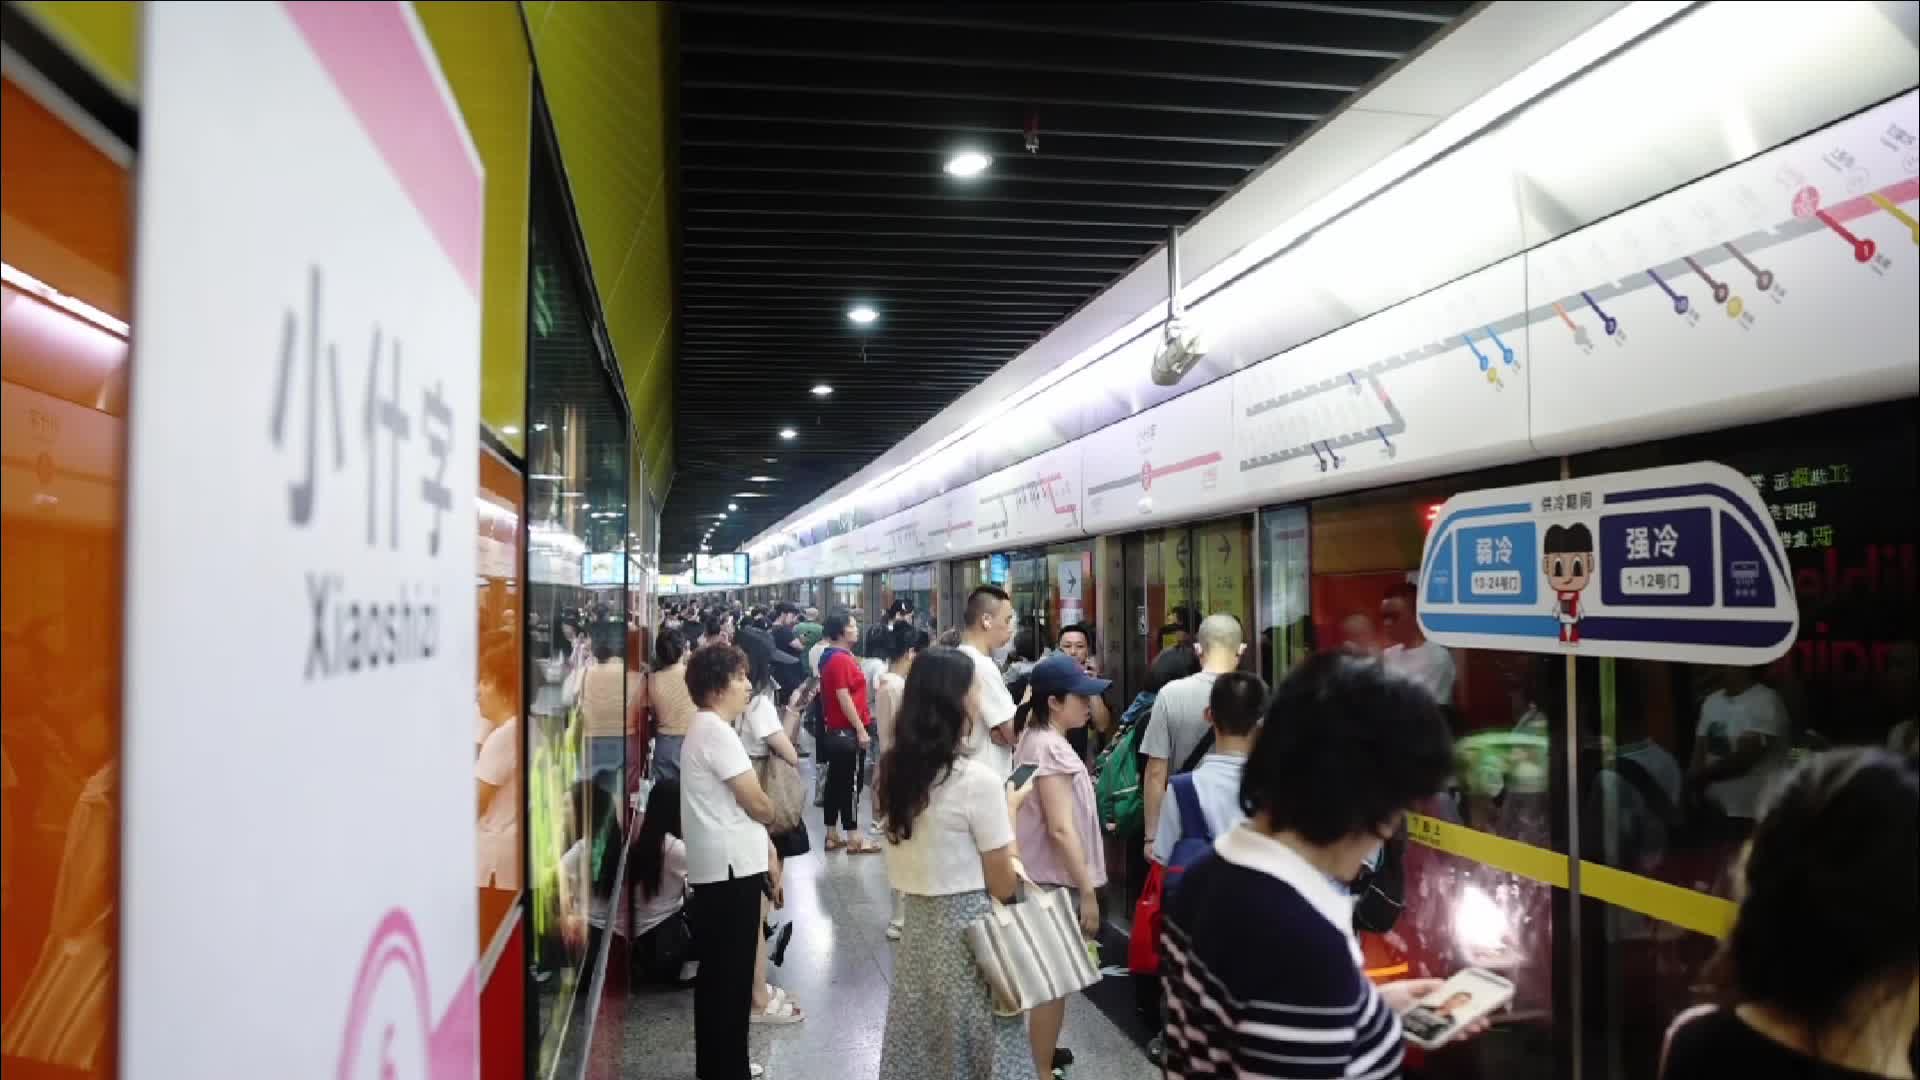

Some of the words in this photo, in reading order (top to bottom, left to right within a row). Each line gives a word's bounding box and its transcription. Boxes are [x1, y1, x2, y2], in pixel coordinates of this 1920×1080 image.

[267, 262, 453, 558] 小什字
[1541, 491, 1593, 512] 供冷期间
[1475, 535, 1513, 566] 弱冷
[1625, 523, 1680, 560] 强冷
[1474, 575, 1519, 592] 13-24号门
[1626, 573, 1681, 590] 1-12号门
[303, 572, 441, 680] Xiaoshizi
